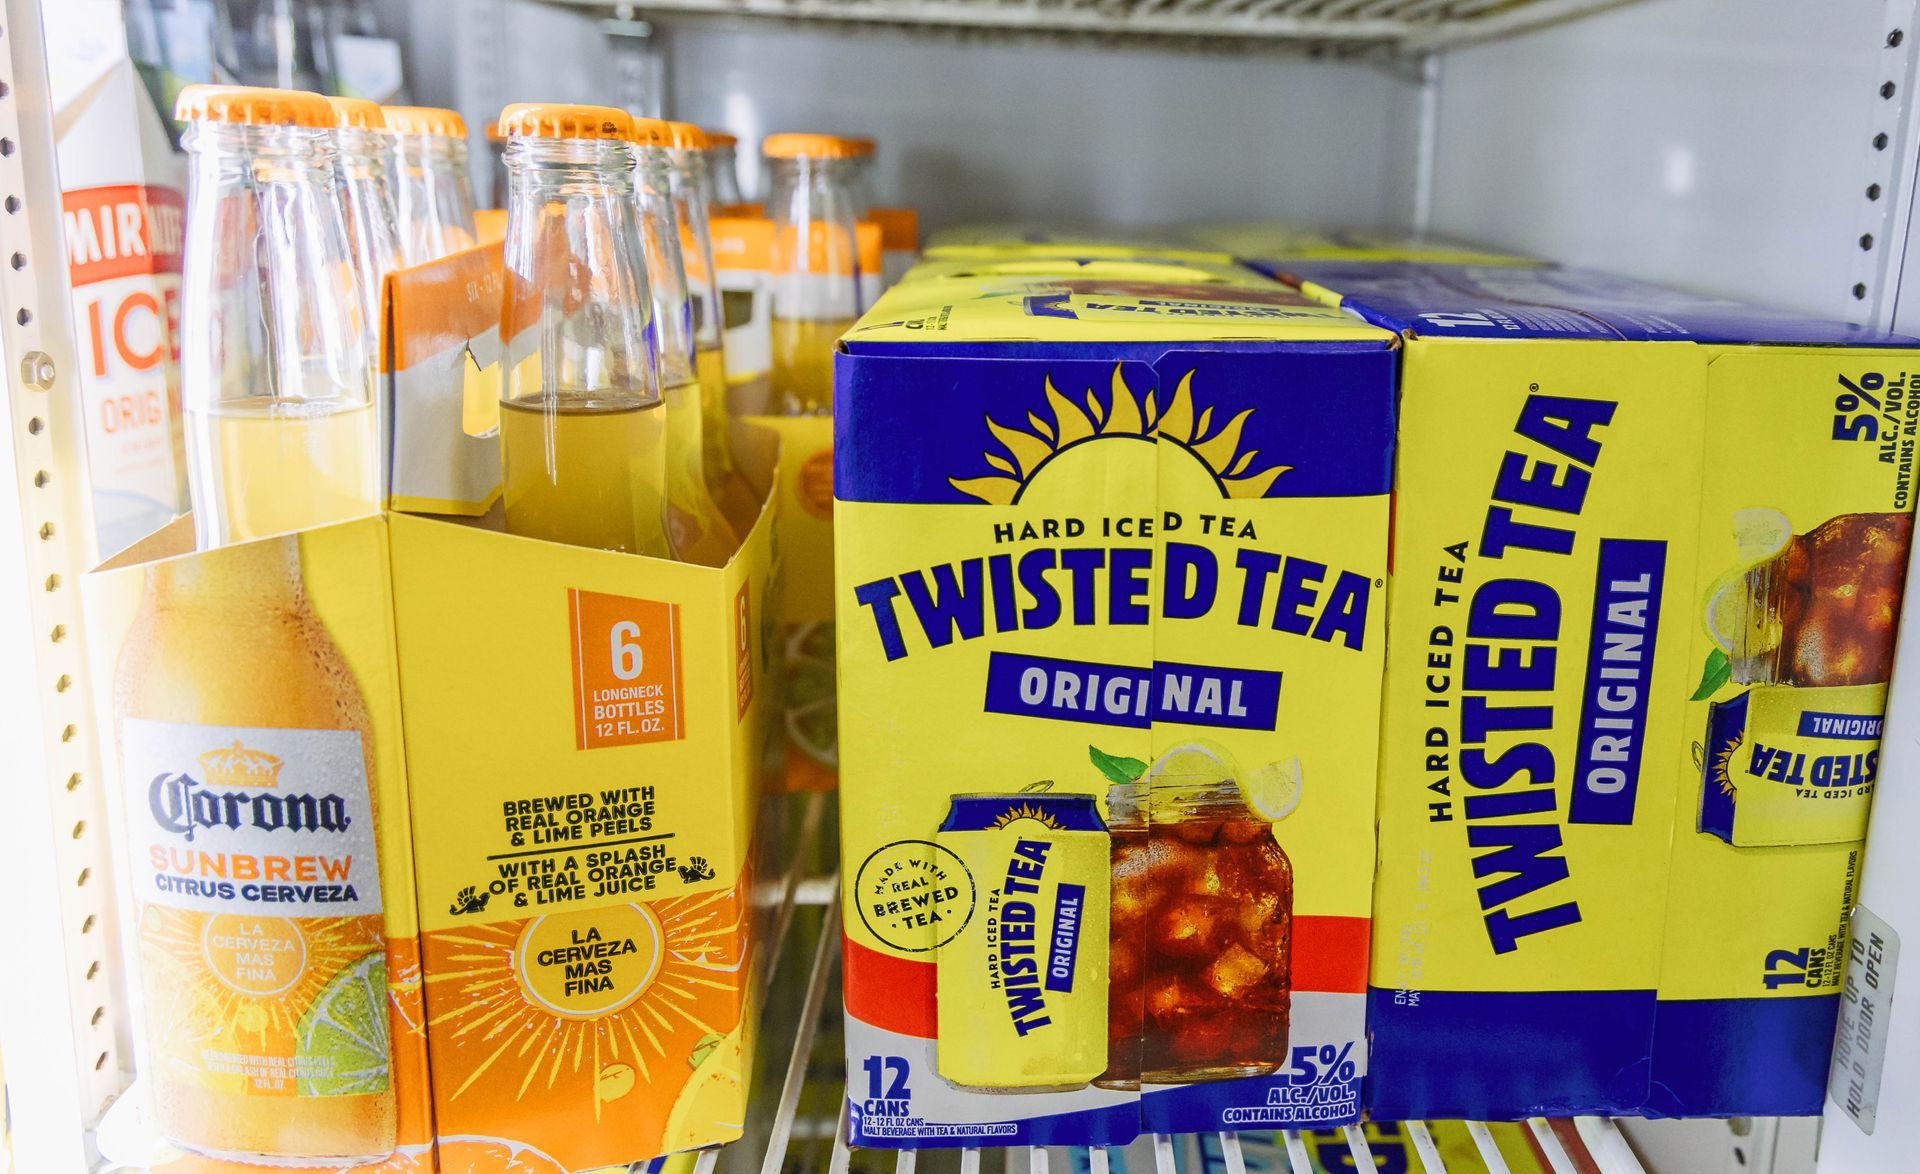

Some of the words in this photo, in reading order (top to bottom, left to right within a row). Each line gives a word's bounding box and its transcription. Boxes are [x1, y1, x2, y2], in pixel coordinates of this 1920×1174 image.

[64, 203, 182, 265] MIR
[1832, 372, 1884, 441] 5%
[1879, 372, 1906, 464] ALC./VOL.
[1478, 394, 1618, 559] TEA
[1894, 440, 1915, 509] CONTAINS
[994, 518, 1085, 543] HARD
[1103, 511, 1183, 538] ICED
[1200, 515, 1258, 540] TEA
[1434, 540, 1469, 606] TEA
[854, 541, 1219, 662] TWISTED
[1235, 548, 1371, 652] TEA
[740, 596, 746, 651] 6
[610, 621, 643, 680] 6
[1424, 625, 1454, 707] ICED
[593, 685, 663, 702] LONGNECK
[1020, 667, 1247, 717] ORIGINAL
[1587, 573, 1651, 794] ORIGINAL
[594, 700, 664, 720] BOTTLES
[595, 722, 613, 737] 12
[617, 720, 639, 736] FL.
[641, 718, 665, 733] OZ.
[1425, 726, 1453, 822] HARD
[1459, 578, 1582, 955] TWISTED
[1749, 742, 1806, 786] TEA
[1810, 749, 1878, 787] STED
[503, 793, 593, 817] BREWED
[600, 786, 655, 805] WITH
[1796, 788, 1818, 798] TEA
[1824, 789, 1851, 798] ICED
[1857, 785, 1873, 796] RD
[505, 813, 559, 831] REAL
[566, 800, 655, 825] ORANGE
[510, 832, 525, 847] &
[534, 824, 583, 844] LIME
[590, 817, 652, 837] PEELS
[149, 844, 352, 882] SUNBREW
[489, 879, 519, 895] OF
[527, 872, 581, 891] REAL
[587, 857, 677, 883] ORANGE
[498, 858, 555, 879] WITH
[564, 856, 578, 871] A
[586, 844, 666, 868] SPLASH
[874, 862, 903, 895] MADE
[909, 859, 947, 880] WITH
[1004, 839, 1052, 895] TEA
[1847, 850, 1858, 877] FLAVORS
[155, 874, 236, 900] CITRUS
[241, 884, 358, 903] CERVEZA
[513, 892, 528, 907] &
[537, 884, 585, 905] LIME
[593, 875, 656, 897] JUICE
[892, 877, 928, 893] REAL
[989, 888, 1001, 911] TEA
[1843, 878, 1854, 905] NATURAL
[873, 887, 958, 917] BREWED
[1840, 912, 1849, 923] TEA
[240, 922, 263, 935] LA
[902, 910, 942, 929] TEA
[988, 917, 997, 948] ICED
[1839, 923, 1847, 939] WITH
[211, 936, 295, 952] CERVEZA
[571, 927, 602, 945] LA
[1053, 898, 1078, 978] ORIGINAL
[1828, 934, 1837, 950] CANS
[1850, 937, 1865, 966] TO
[236, 952, 274, 966] MAS
[537, 938, 637, 966] CERVEZA
[1865, 932, 1884, 990] OPEN
[236, 968, 277, 981] FINA
[564, 959, 612, 980] MAS
[989, 954, 1001, 989] HARD
[1001, 901, 1052, 1037] TWISTED
[1762, 948, 1810, 989] 12
[1806, 948, 1826, 988] CANS
[564, 975, 614, 997] FINA
[1845, 975, 1860, 1005] UP
[1856, 996, 1875, 1054] DOOR
[863, 1055, 911, 1100] 12
[1290, 1041, 1355, 1085] 5%
[1268, 1085, 1355, 1104] ALC./VOL.
[1846, 1063, 1865, 1119] HOLD
[864, 1100, 910, 1117] CANS
[886, 1118, 894, 1126] FL
[895, 1117, 904, 1126] OZ
[906, 1117, 924, 1126] CANS
[1224, 1107, 1292, 1123] CONTAINS
[1294, 1103, 1355, 1119] ALCOHOL
[864, 1126, 880, 1135] MALT
[882, 1127, 916, 1136] BEVERAGE
[918, 1127, 935, 1136] WITH
[936, 1127, 948, 1135] TEA
[950, 1127, 955, 1135] &
[957, 1126, 985, 1135] NATURAL
[987, 1125, 1016, 1134] FLAVORS
